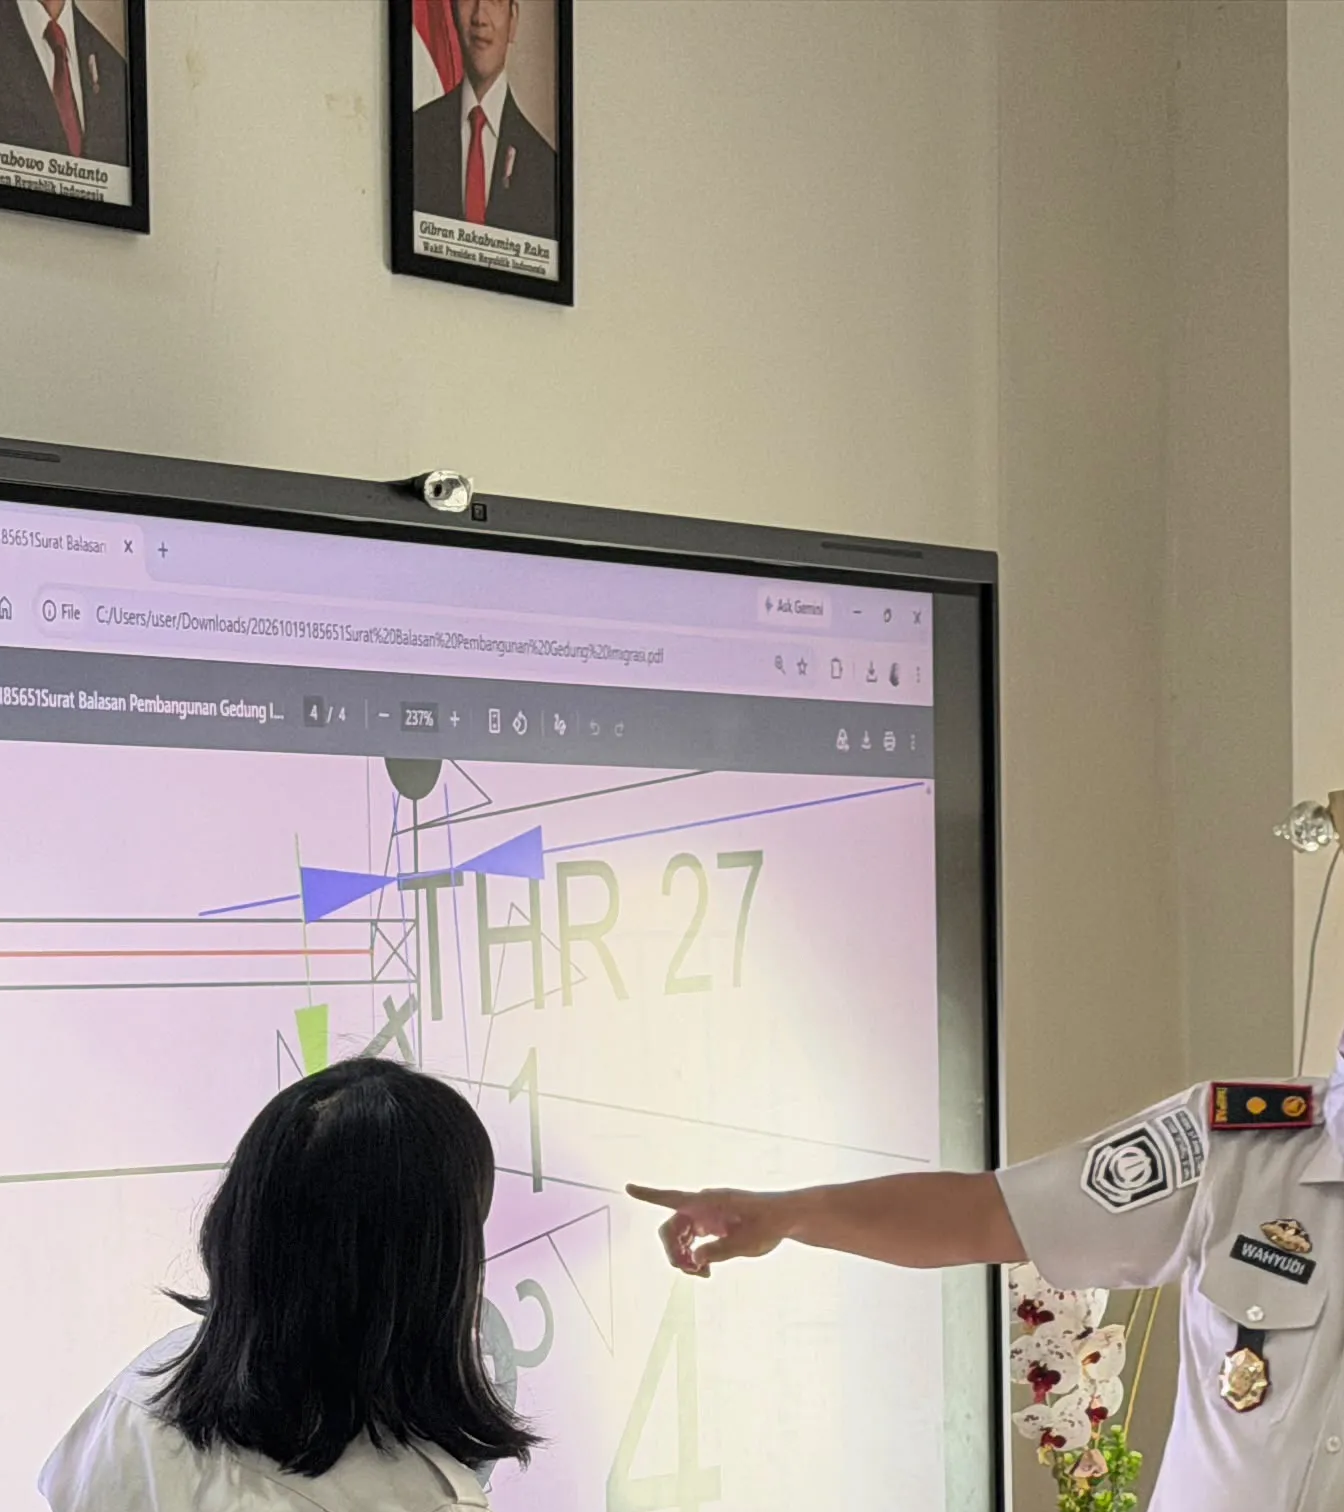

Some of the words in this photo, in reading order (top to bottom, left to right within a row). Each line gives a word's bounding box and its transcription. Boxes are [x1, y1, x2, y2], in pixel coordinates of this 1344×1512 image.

[47, 159, 108, 183] Subianto
[419, 220, 455, 241] Gibran
[457, 228, 521, 257] Rakabuming
[523, 242, 550, 259] Raka
[61, 603, 81, 621] File
[777, 598, 793, 614] Ask
[78, 690, 127, 712] Balasan
[129, 693, 217, 720] Pembangunan
[219, 699, 266, 724] Gedung
[309, 704, 319, 721] 4
[338, 707, 346, 721] 4
[404, 709, 434, 727] 237%
[398, 859, 630, 1021] THR
[661, 849, 764, 996] 27
[1241, 1242, 1306, 1276] WAHYUDI
